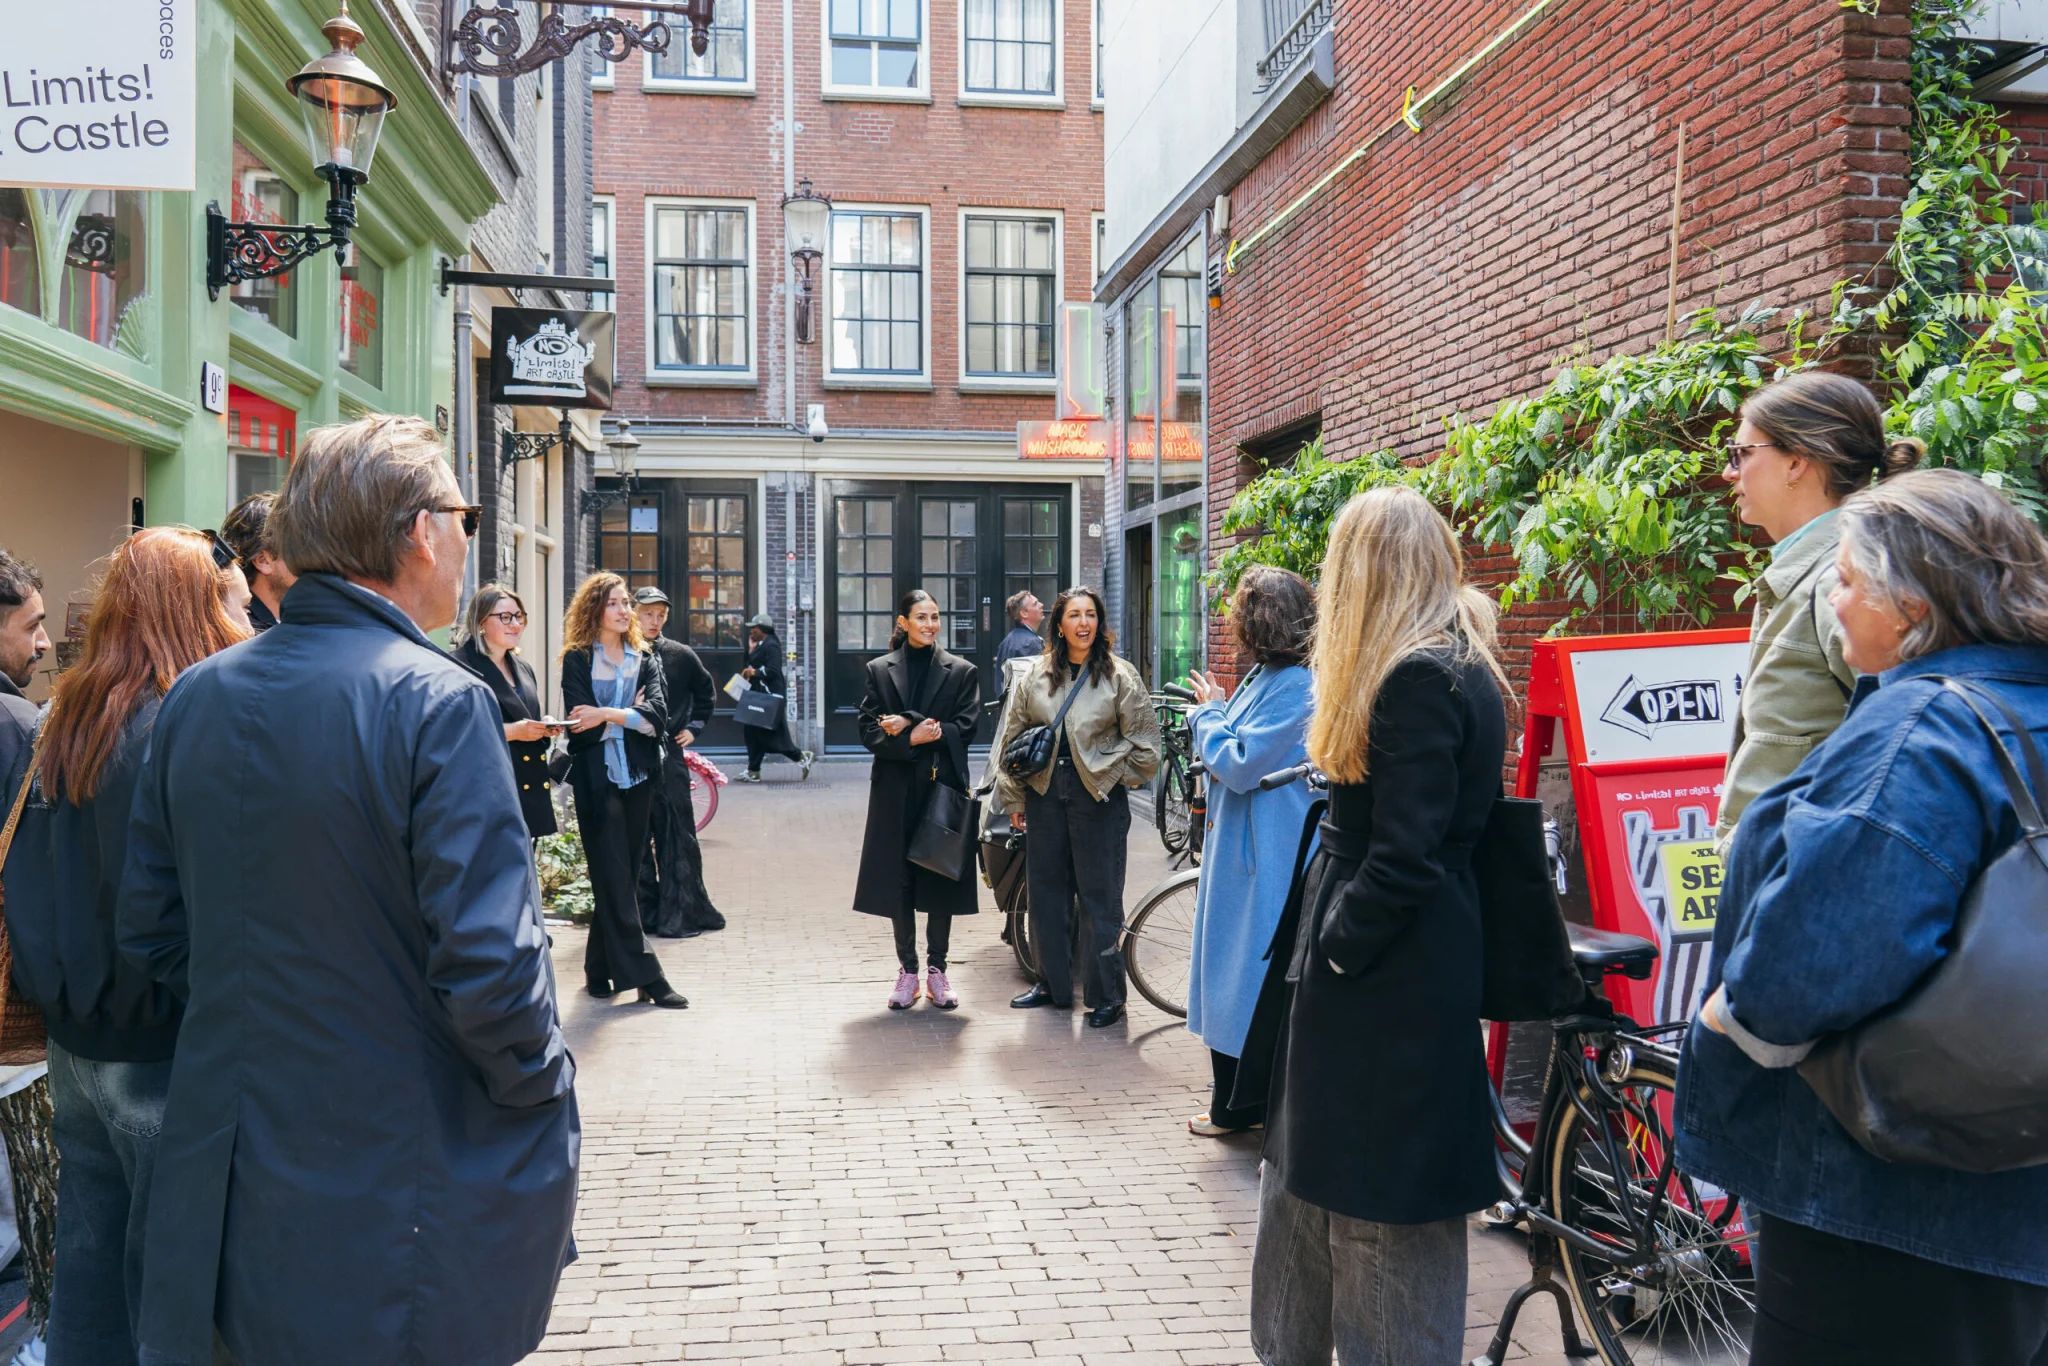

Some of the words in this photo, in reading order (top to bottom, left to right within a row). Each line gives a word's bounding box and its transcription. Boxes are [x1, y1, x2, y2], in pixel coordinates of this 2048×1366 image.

[3, 63, 154, 107] Limits!
[14, 111, 170, 154] Castle
[538, 338, 566, 354] NO
[526, 368, 543, 377] ART
[1046, 422, 1087, 439] MAGIC
[1026, 440, 1107, 456] MUSHROOMS
[1640, 685, 1718, 723] OPEN
[1616, 792, 1632, 802] NO
[1680, 863, 1723, 890] SE
